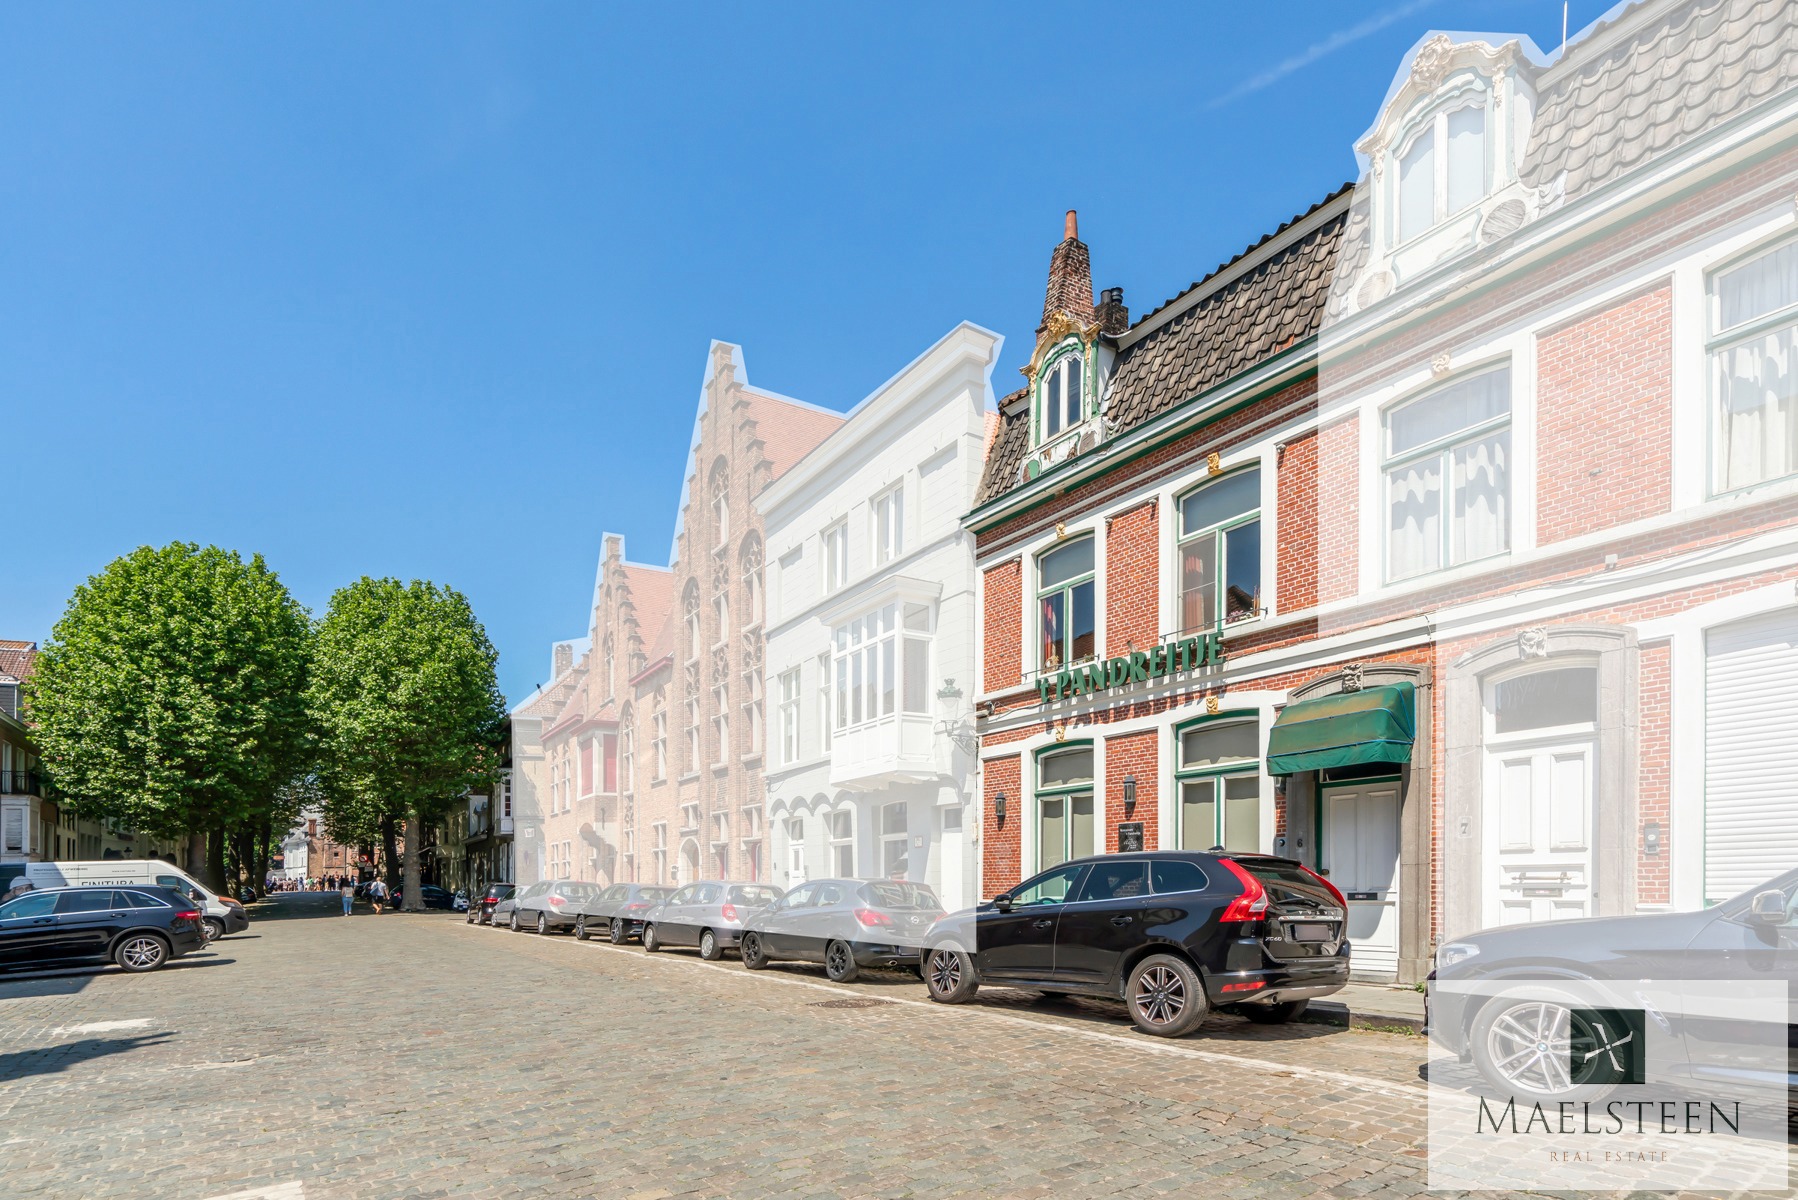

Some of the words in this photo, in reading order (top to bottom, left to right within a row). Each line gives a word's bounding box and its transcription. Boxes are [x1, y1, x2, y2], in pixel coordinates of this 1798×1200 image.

[1056, 631, 1226, 700] PANDREITJE
[1460, 822, 1469, 835] 7
[1297, 838, 1303, 848] 6
